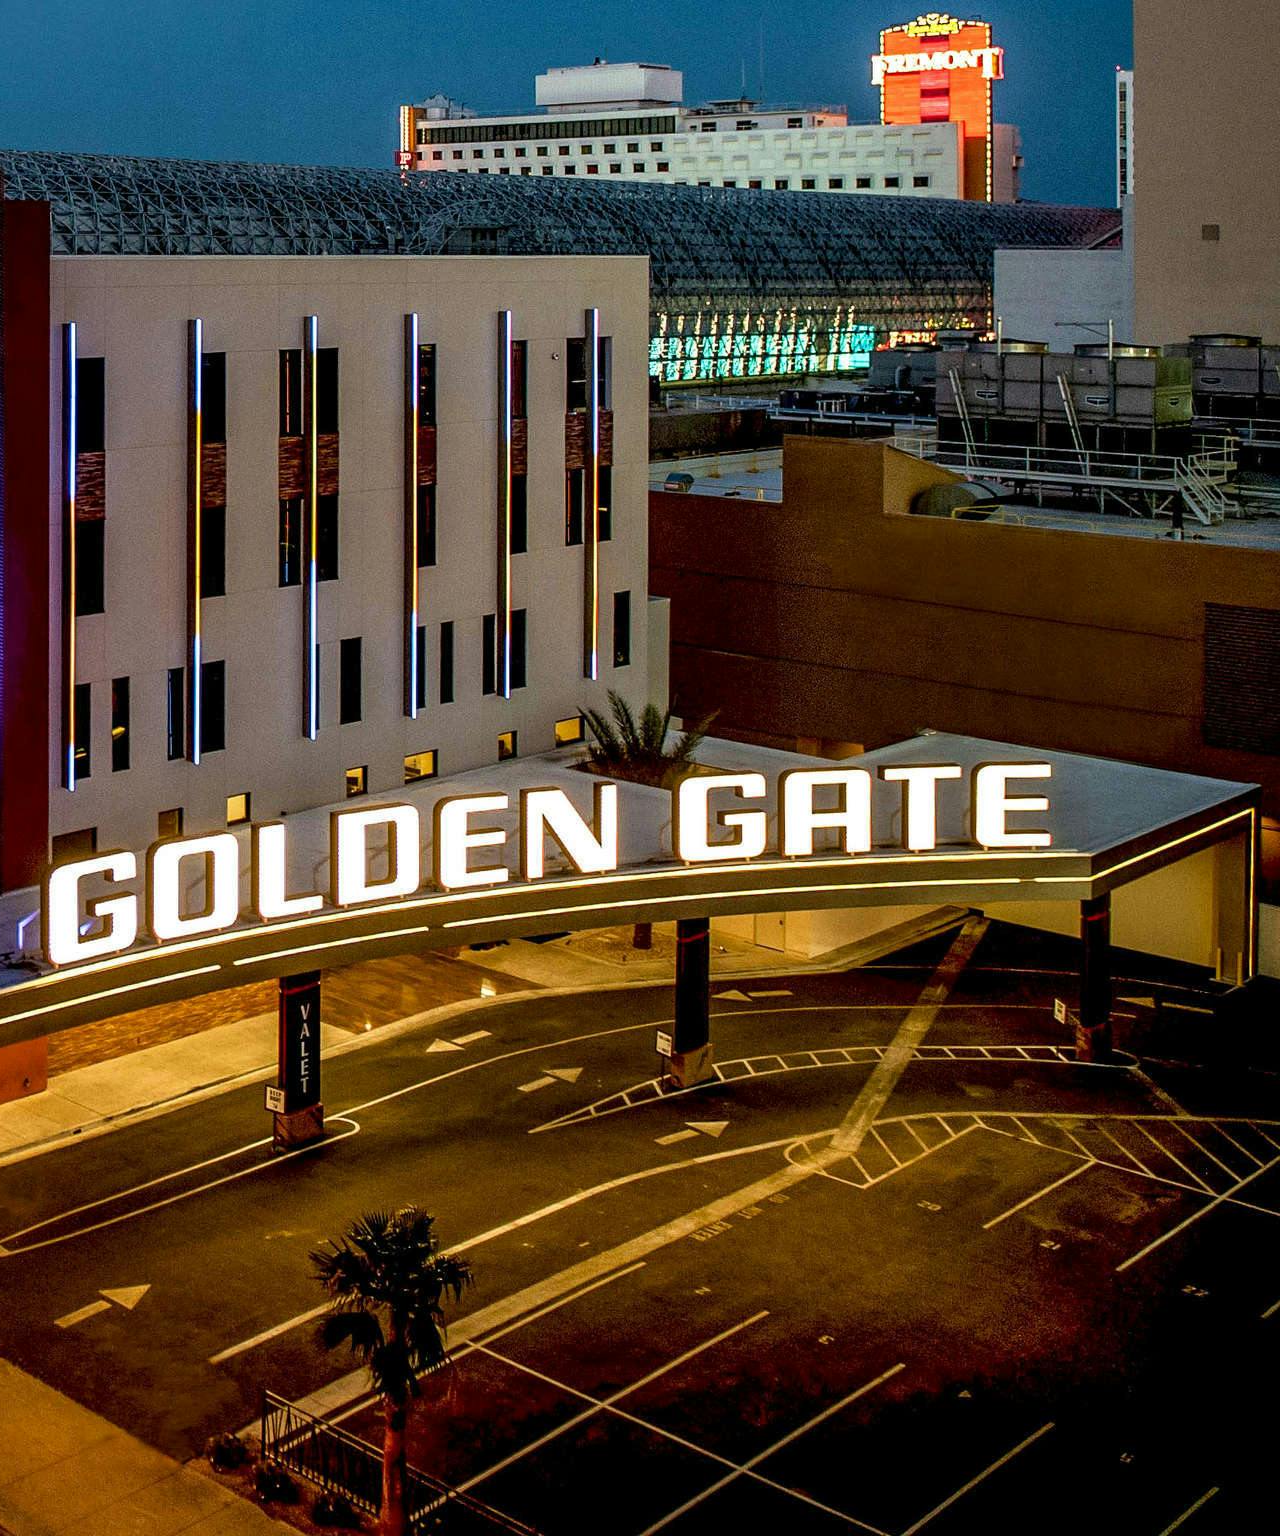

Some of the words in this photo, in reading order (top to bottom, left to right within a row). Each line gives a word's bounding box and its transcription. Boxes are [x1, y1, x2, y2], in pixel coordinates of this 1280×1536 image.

[871, 47, 1000, 85] FREMONT
[42, 781, 618, 967] GOLDEN
[675, 762, 1053, 864] GATE
[300, 1003, 310, 1093] VALET
